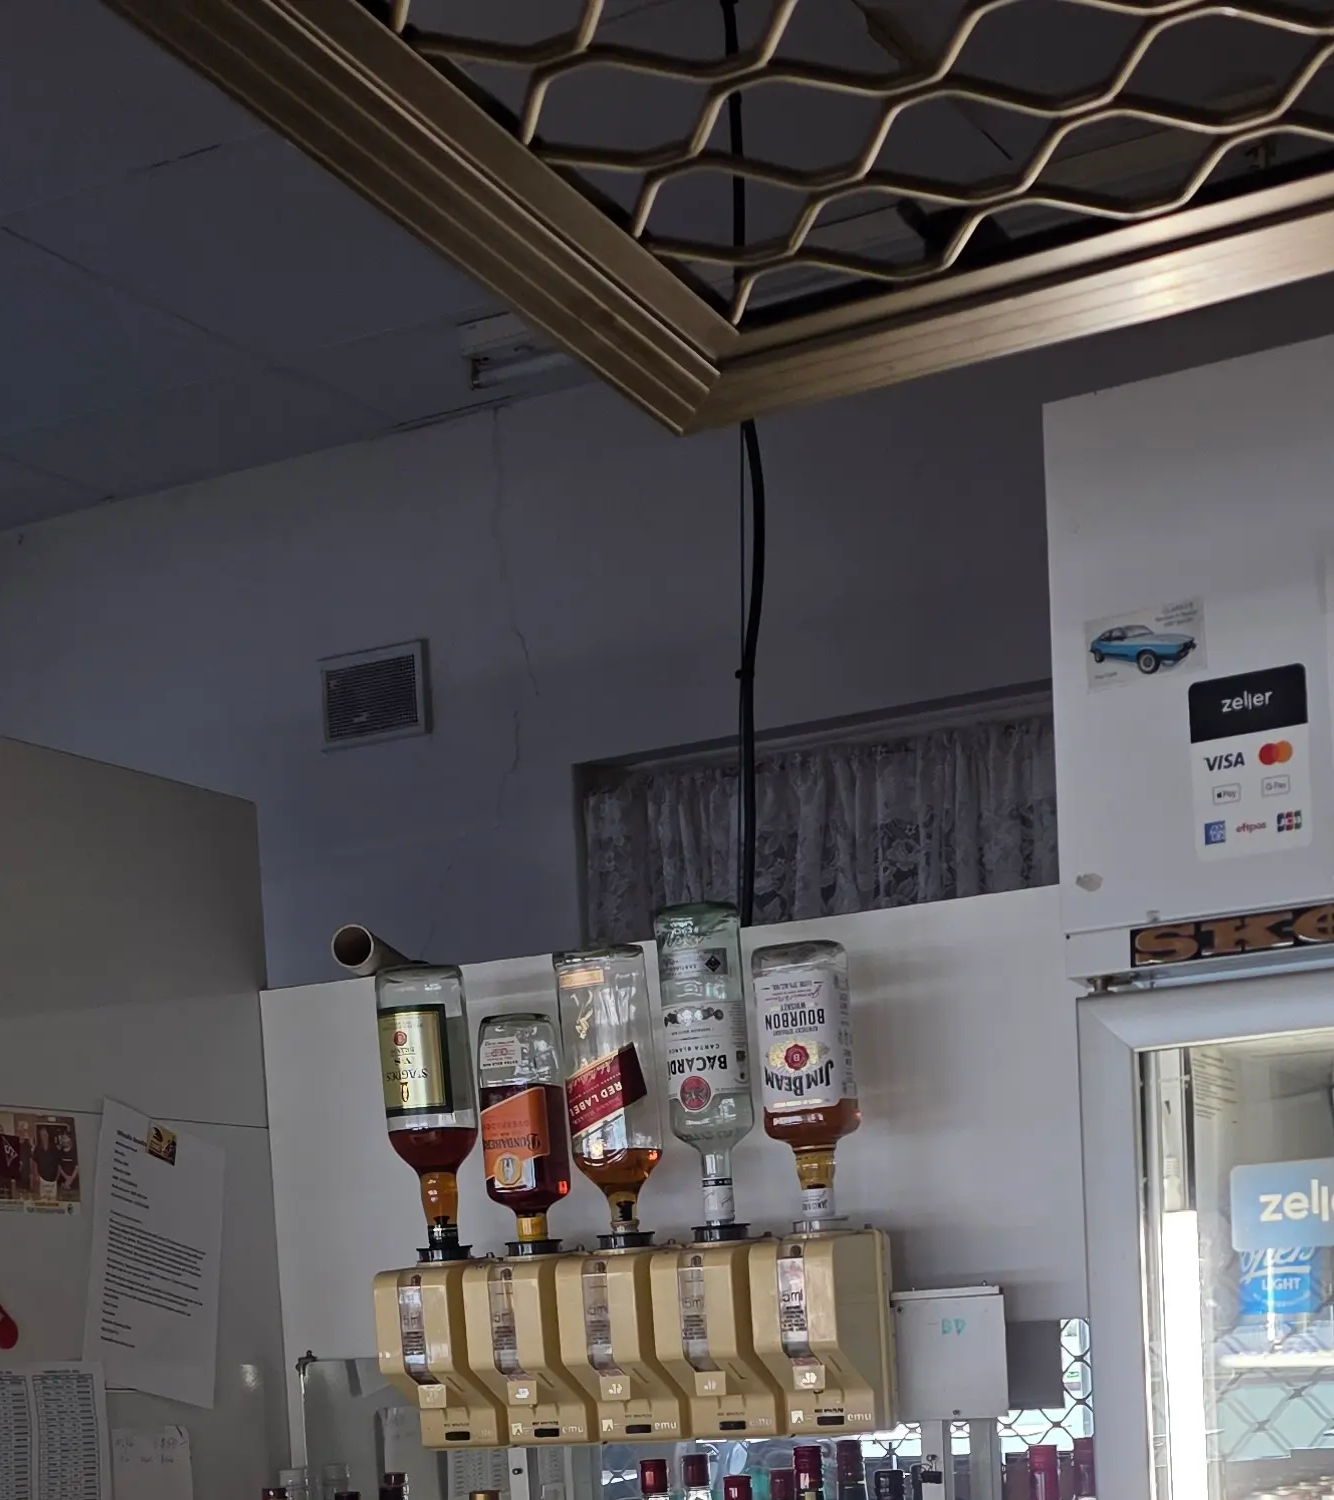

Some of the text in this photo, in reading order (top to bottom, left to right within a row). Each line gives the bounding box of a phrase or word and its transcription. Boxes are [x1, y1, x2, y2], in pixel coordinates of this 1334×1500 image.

[1220, 689, 1274, 714] zeller
[1203, 751, 1246, 772] VISA
[765, 1007, 826, 1031] BOURBON
[764, 1059, 834, 1097] JIM BEAM
[601, 1082, 623, 1101] RED
[847, 1411, 874, 1423] emu
